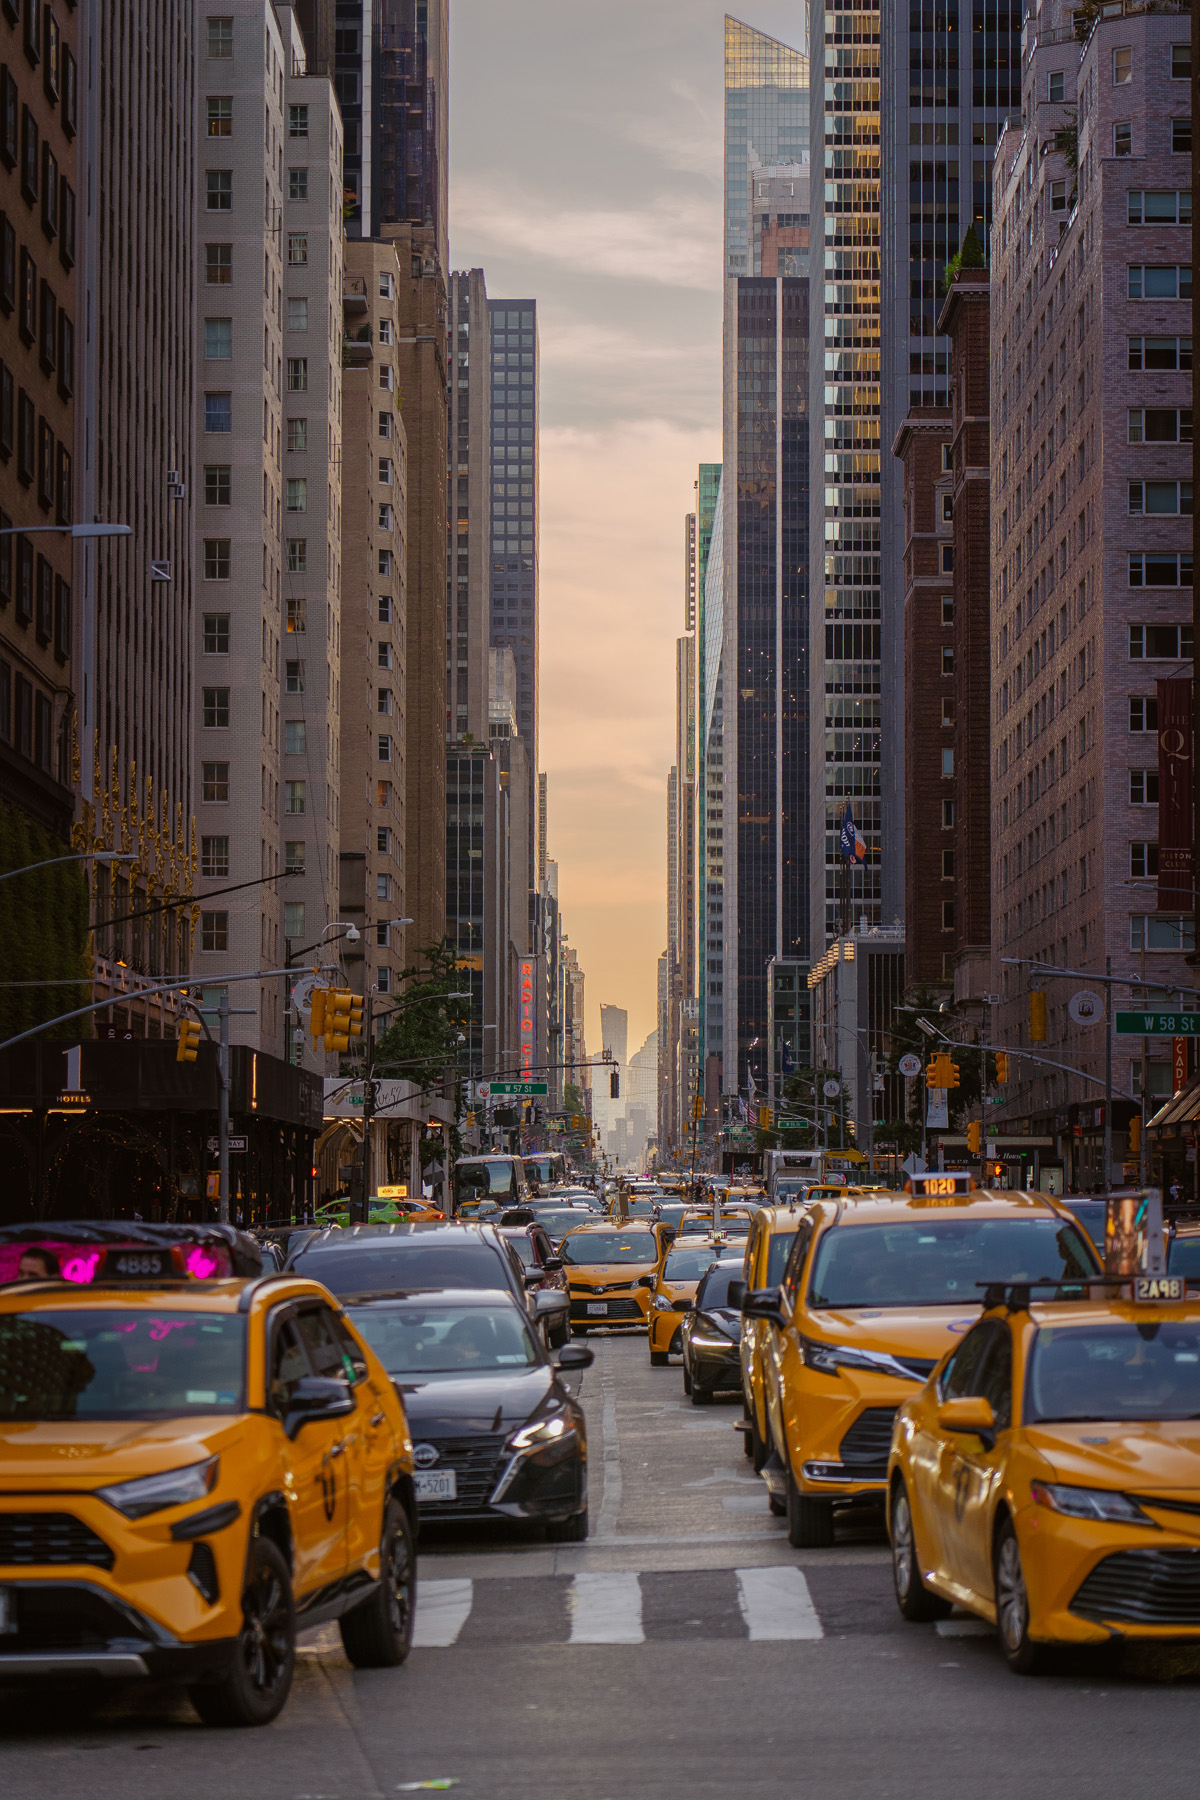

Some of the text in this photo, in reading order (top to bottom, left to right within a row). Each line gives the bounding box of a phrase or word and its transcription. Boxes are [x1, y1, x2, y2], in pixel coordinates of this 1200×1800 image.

[1160, 852, 1192, 860] HILTON
[1165, 860, 1187, 869] CLUB
[521, 963, 533, 1031] RADIO
[1144, 1016, 1195, 1031] W 58 St
[62, 1045, 86, 1092] 1
[522, 1043, 532, 1083] CIT
[505, 1085, 532, 1093] W 57 St
[923, 1179, 956, 1195] 1020
[1138, 1280, 1180, 1299] 2A98
[415, 1479, 450, 1494] M-5201
